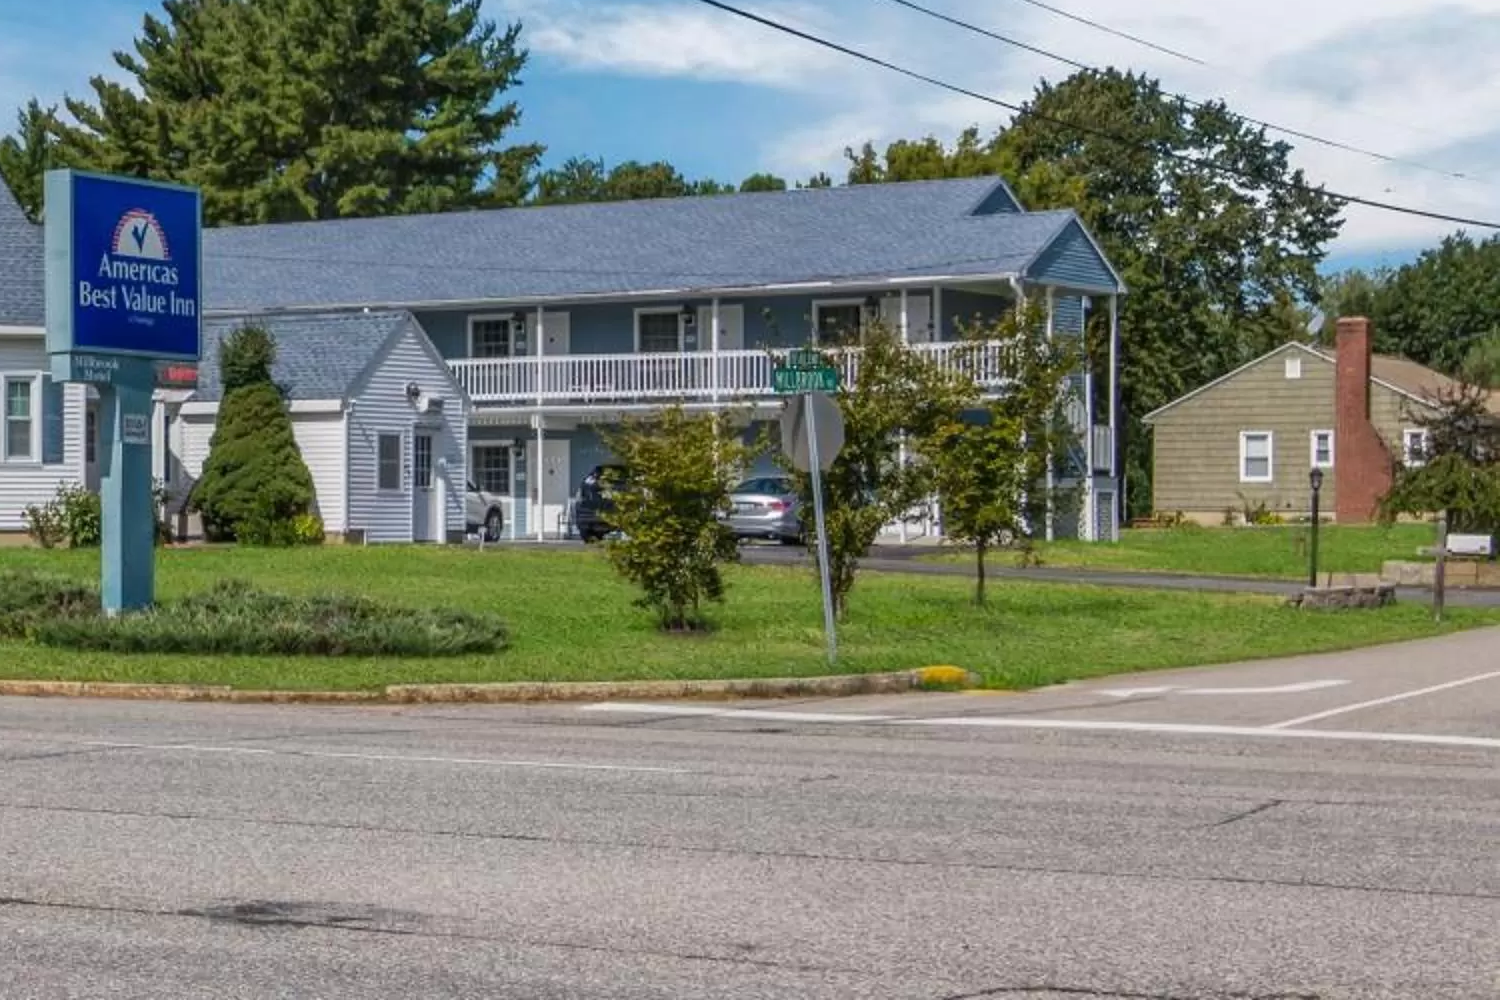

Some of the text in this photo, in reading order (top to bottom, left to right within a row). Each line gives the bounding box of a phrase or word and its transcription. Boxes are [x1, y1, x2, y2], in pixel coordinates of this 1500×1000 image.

[98, 251, 179, 285] Americas
[79, 280, 196, 317] Best Value Inn
